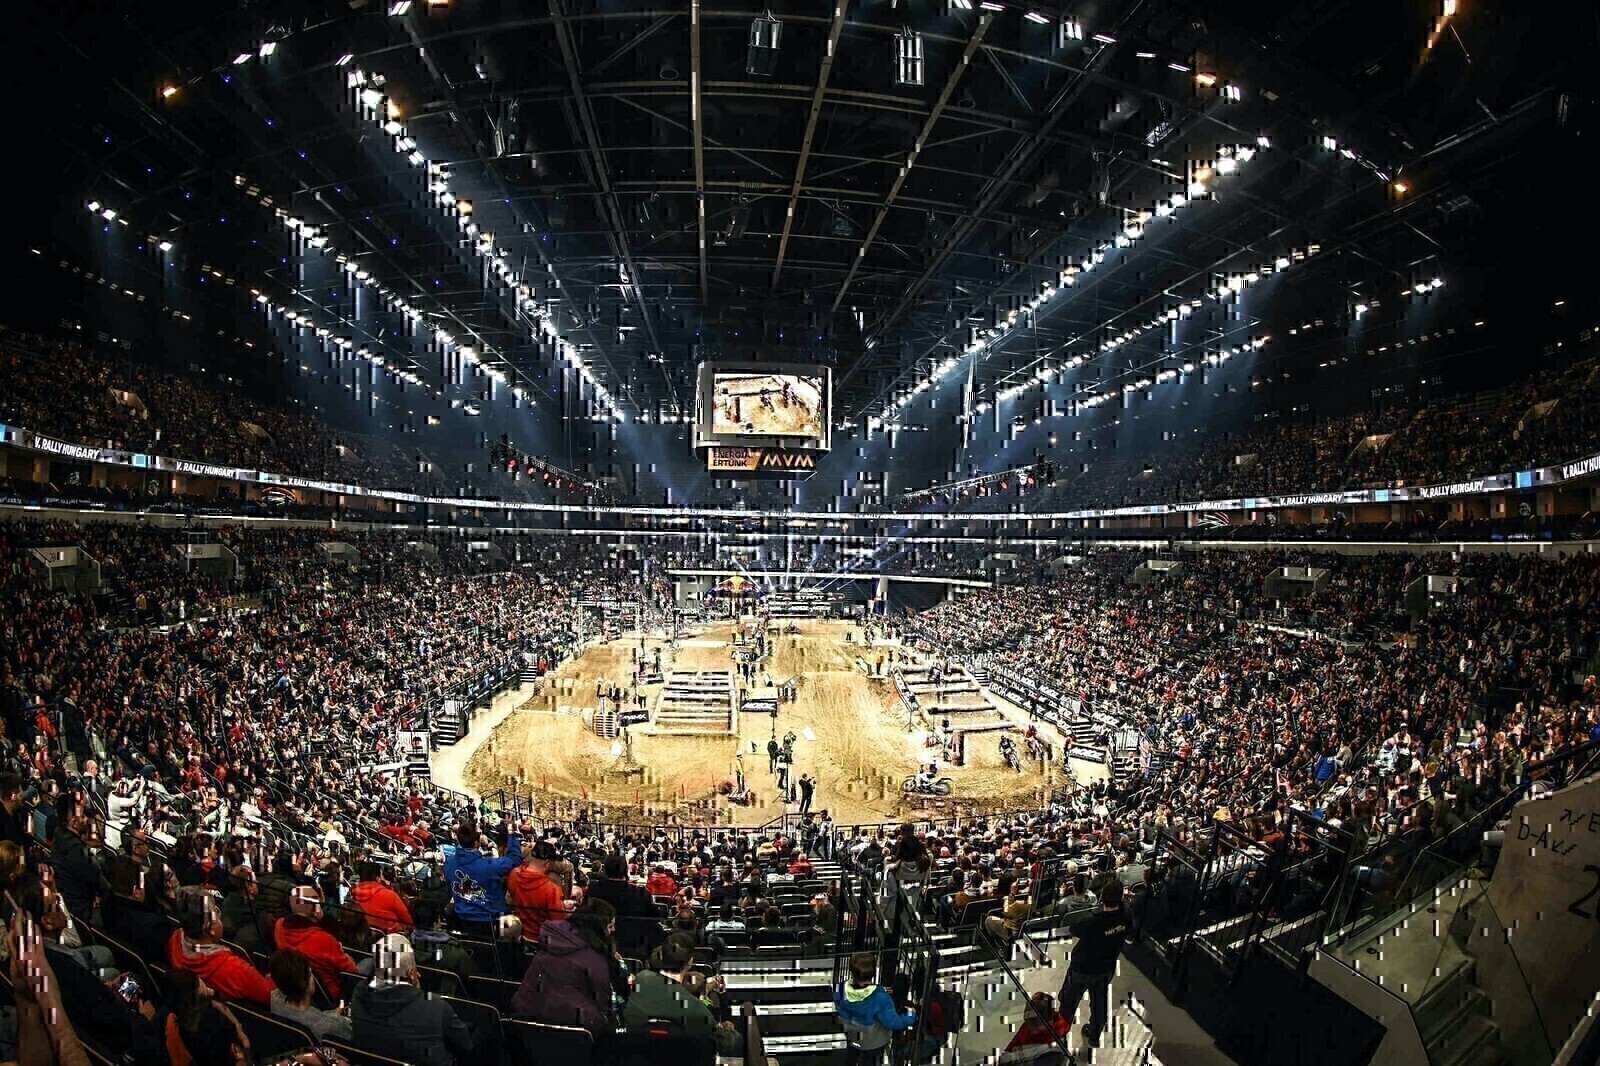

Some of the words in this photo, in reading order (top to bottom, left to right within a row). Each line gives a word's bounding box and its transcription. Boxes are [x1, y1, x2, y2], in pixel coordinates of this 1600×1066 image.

[34, 436, 41, 449] V.
[41, 438, 64, 454] RALLY
[62, 443, 100, 459] HUNGARY
[176, 461, 182, 470] V.
[183, 462, 205, 474] RALLY
[204, 466, 236, 478] HUNGARY
[762, 454, 814, 468] MVM
[1563, 465, 1569, 479] V.
[1569, 460, 1588, 478] RALLY
[1588, 455, 1600, 472] HU
[294, 478, 308, 486] RALLY
[1422, 488, 1429, 498] V.
[1430, 484, 1449, 497] RALLY
[1449, 480, 1484, 494] HUNGARY
[1196, 502, 1222, 510] HUNGARY
[1280, 496, 1287, 506] V.
[1287, 496, 1308, 505] RALLY
[1308, 494, 1342, 504] HUNGARY
[1568, 864, 1600, 926] 2
